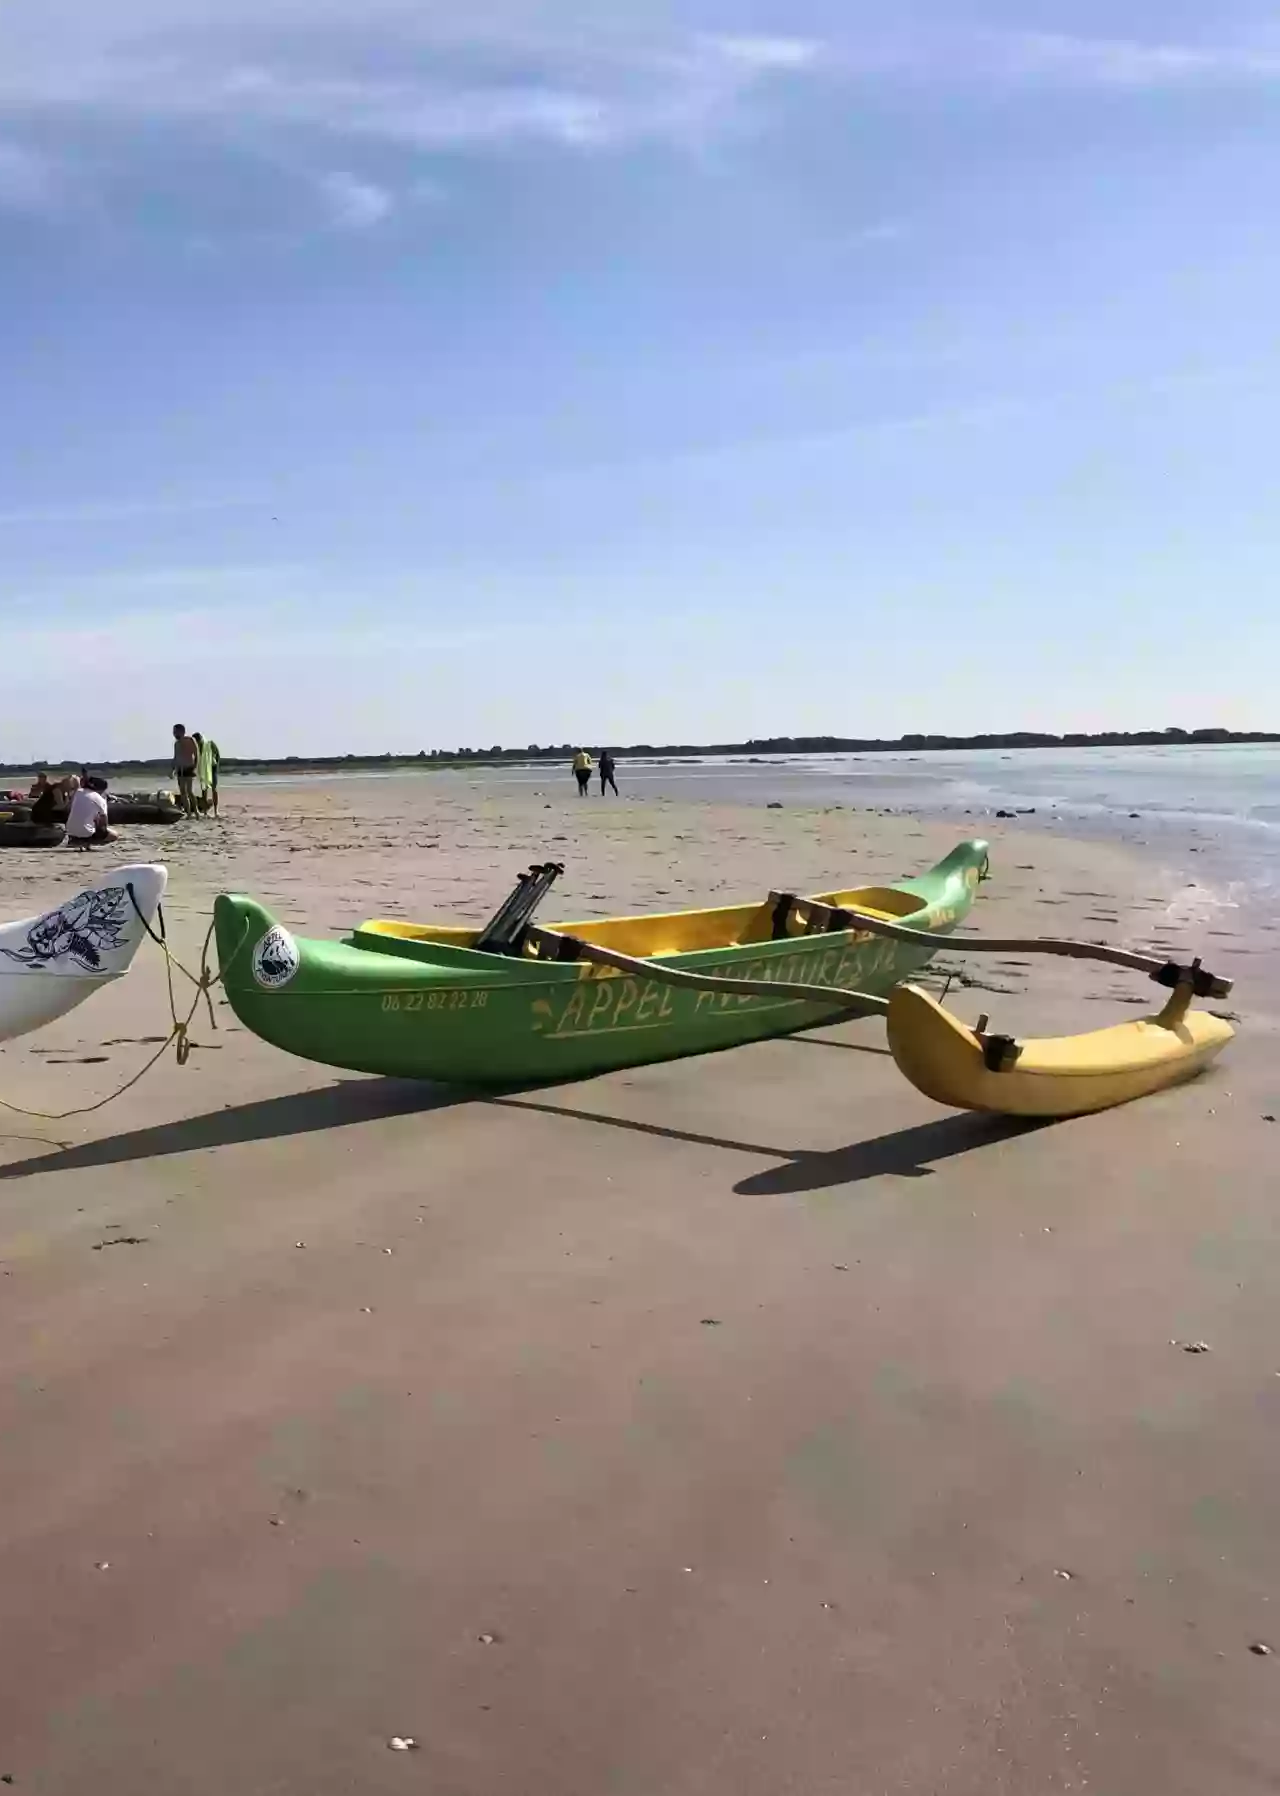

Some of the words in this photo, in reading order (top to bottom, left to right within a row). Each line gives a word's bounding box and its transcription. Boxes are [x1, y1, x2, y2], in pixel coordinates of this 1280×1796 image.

[381, 994, 400, 1012] 06
[403, 993, 425, 1011] 22
[427, 992, 447, 1010] 82
[449, 991, 467, 1010] 22
[470, 990, 489, 1009] 28
[556, 977, 674, 1033] APPEL
